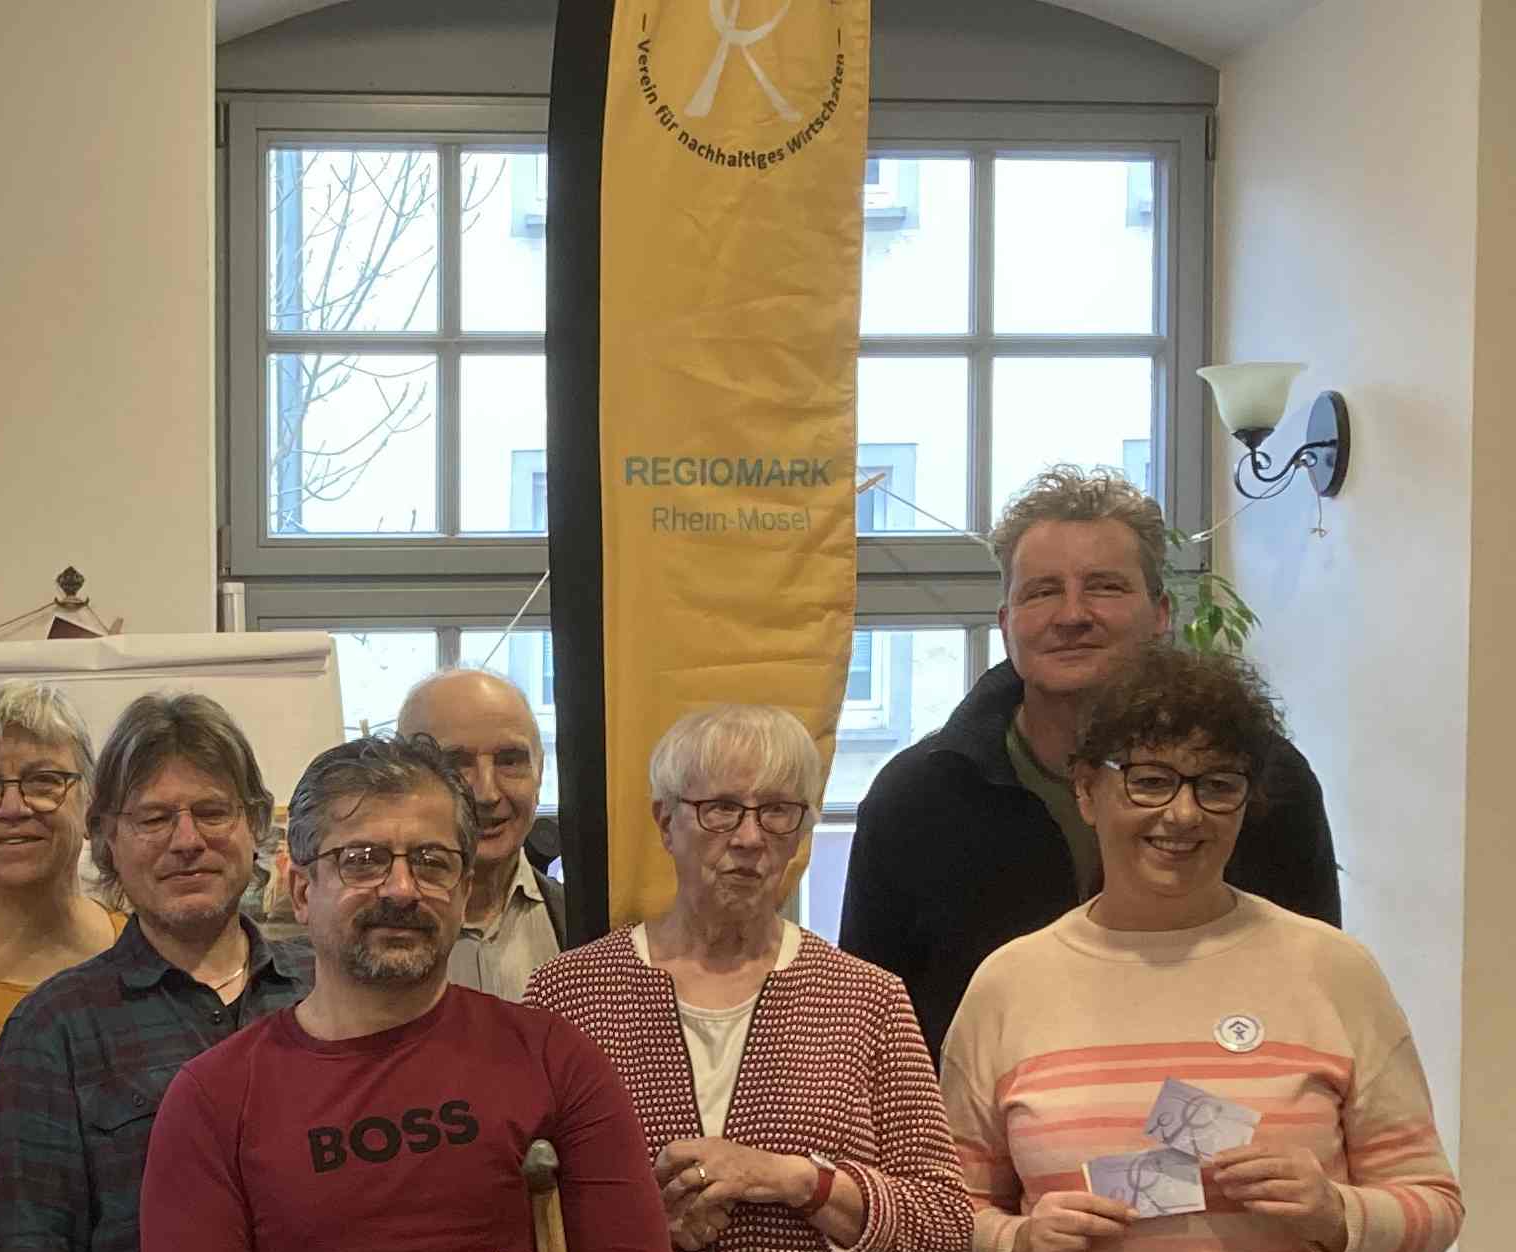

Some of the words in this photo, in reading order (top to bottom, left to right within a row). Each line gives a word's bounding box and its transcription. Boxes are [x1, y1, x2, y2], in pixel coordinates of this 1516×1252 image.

[637, 38, 659, 105] Verein
[655, 104, 679, 132] für
[677, 130, 785, 170] nachhaltiges
[786, 53, 845, 155] Wirtschaften
[624, 456, 833, 487] REGIOMARK
[652, 503, 812, 533] Rhein-Mosel
[307, 1099, 480, 1173] BOSS
